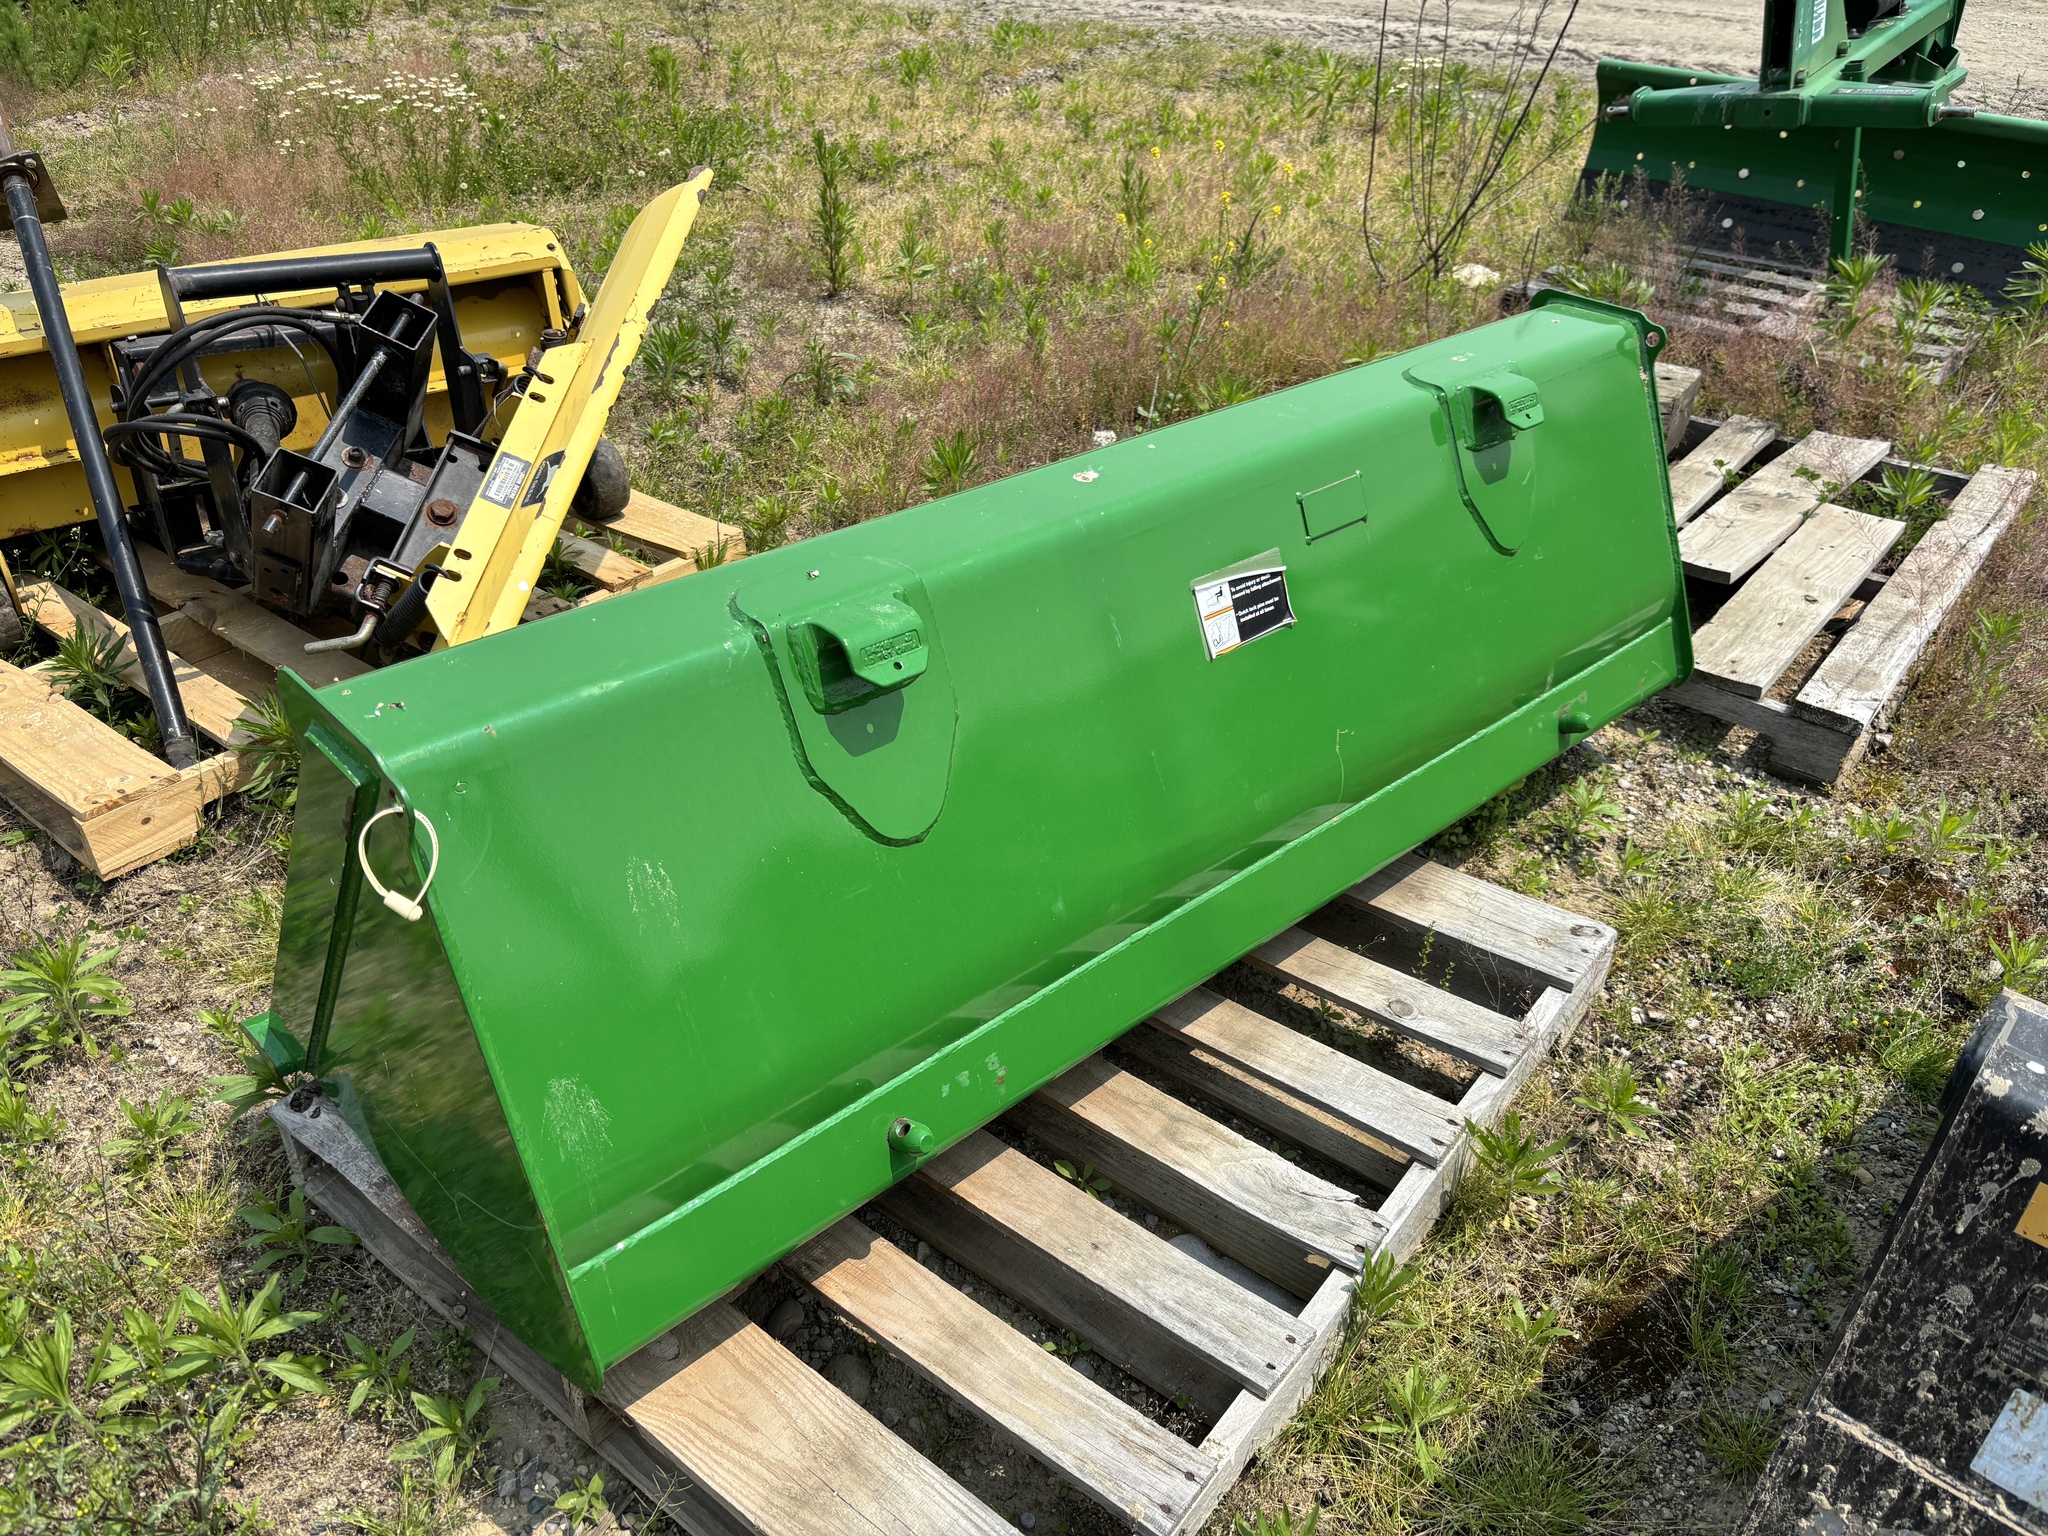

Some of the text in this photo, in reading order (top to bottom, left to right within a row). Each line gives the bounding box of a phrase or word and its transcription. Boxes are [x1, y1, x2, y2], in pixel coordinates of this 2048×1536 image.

[509, 471, 525, 498] JOHN DEERE
[524, 460, 546, 503] JOHN DEERE
[1235, 583, 1246, 591] avoid
[1245, 579, 1256, 587] injury
[1232, 590, 1246, 599] caused
[1238, 608, 1249, 616] Quick
[2007, 1336, 2024, 1348] PART
[2003, 1343, 2023, 1357] MODEL
[2000, 1350, 2019, 1364] WIDTH
